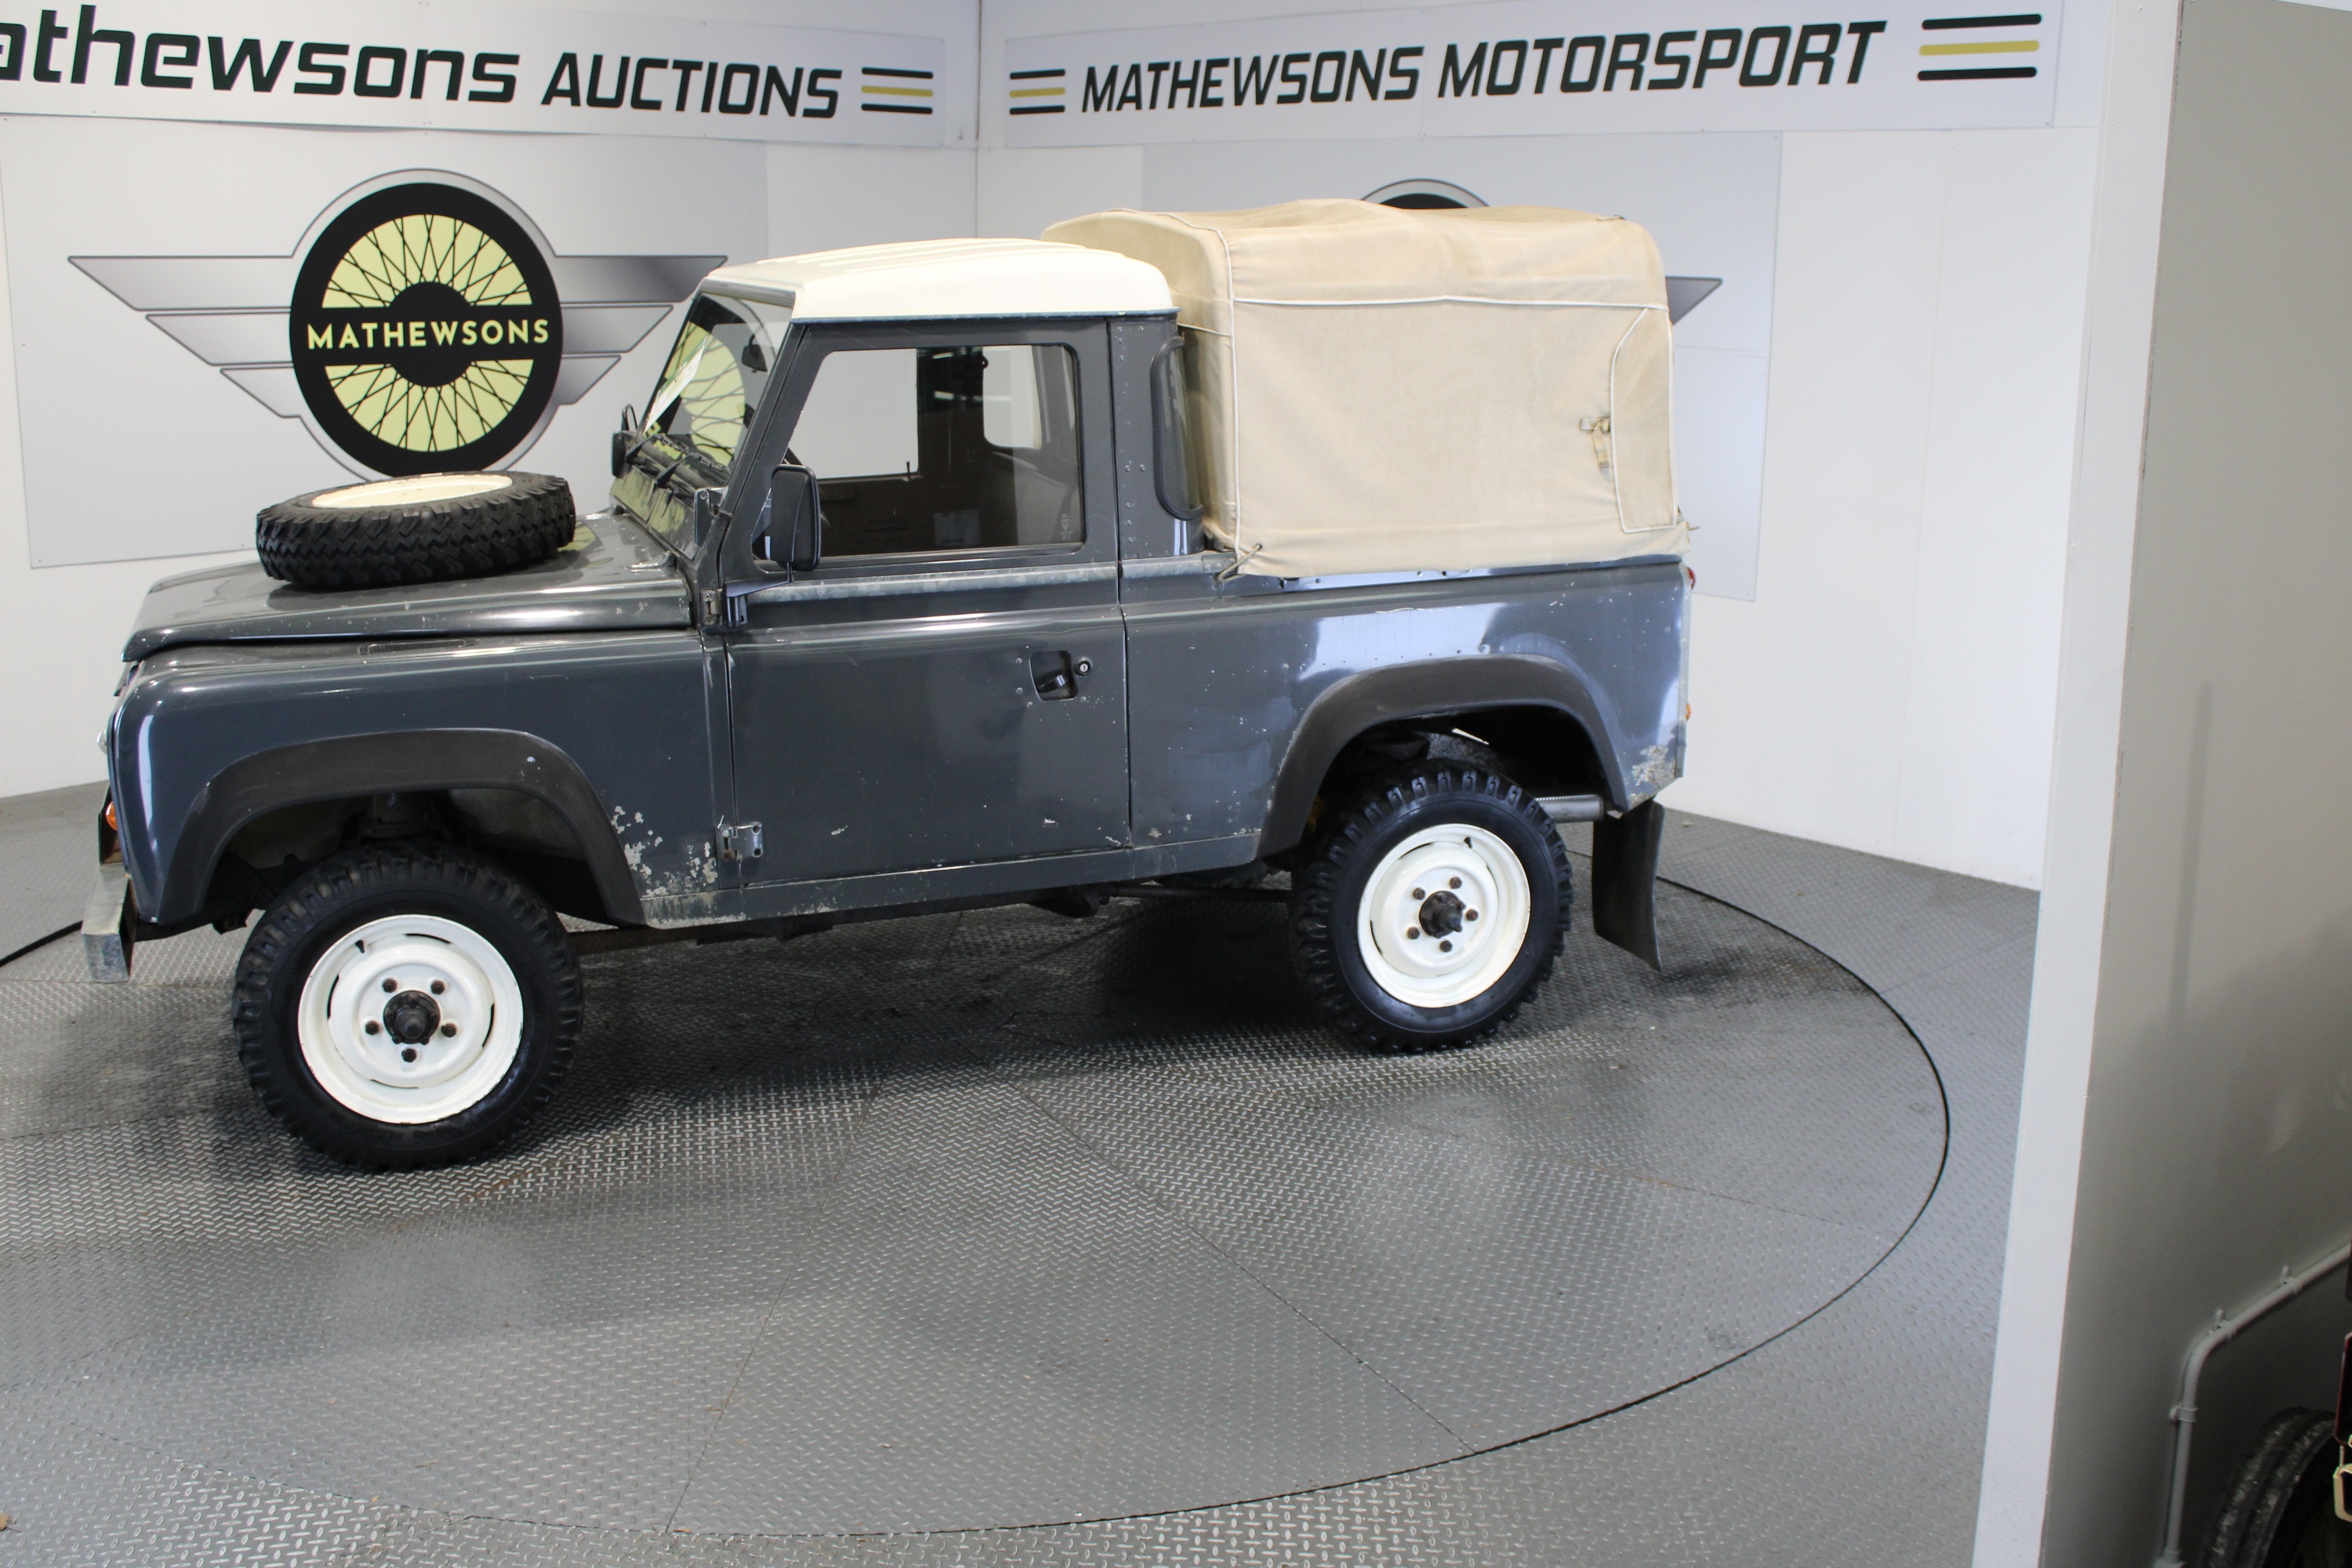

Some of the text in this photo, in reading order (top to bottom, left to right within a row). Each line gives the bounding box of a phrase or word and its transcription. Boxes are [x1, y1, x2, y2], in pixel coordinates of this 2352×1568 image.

[541, 52, 843, 118] AUCTIONS
[1081, 20, 1887, 113] MATHEWSONS MOTORSPORT
[307, 318, 549, 350] MATHEWSONS
